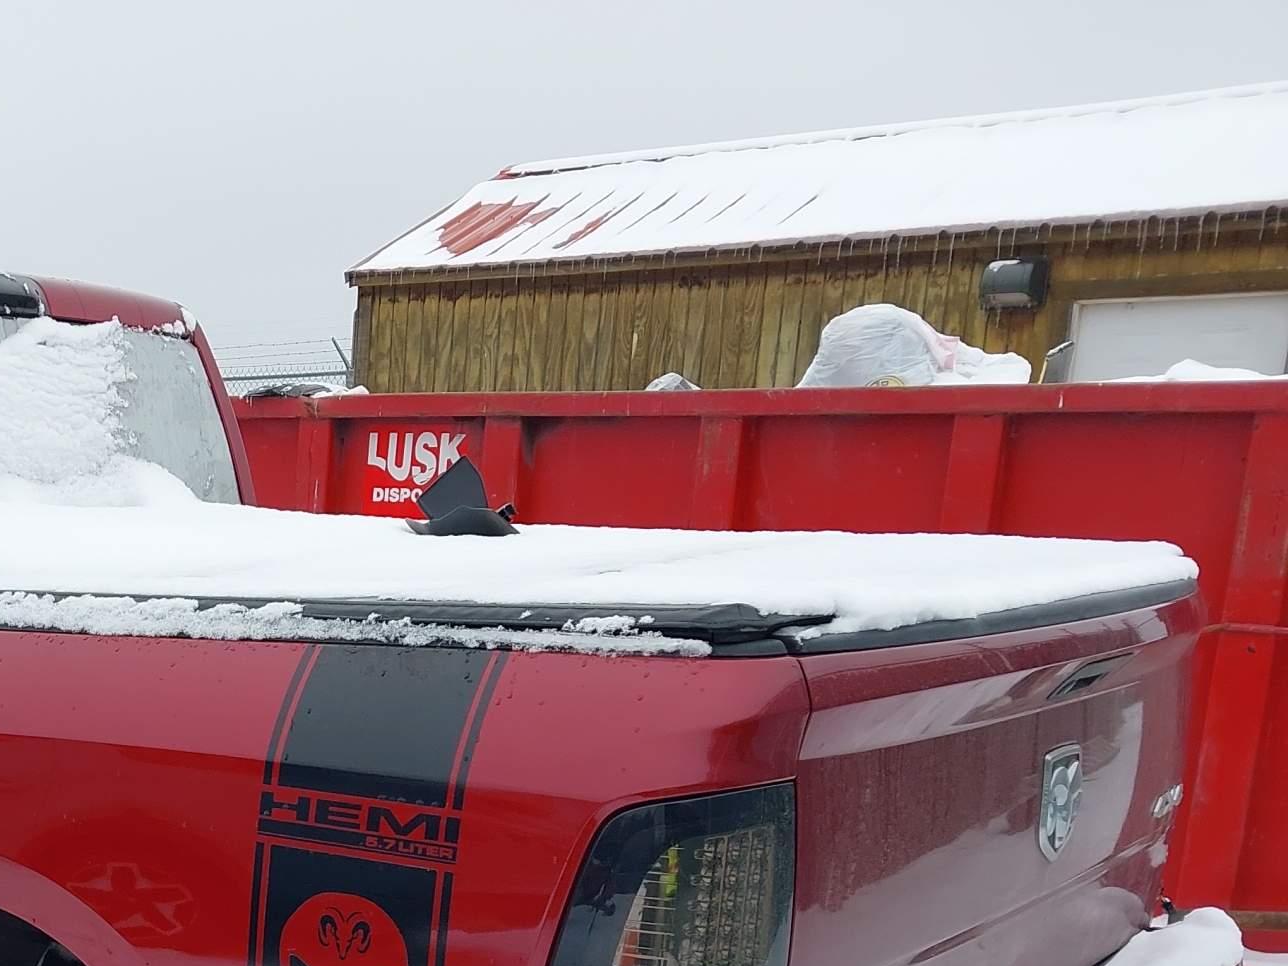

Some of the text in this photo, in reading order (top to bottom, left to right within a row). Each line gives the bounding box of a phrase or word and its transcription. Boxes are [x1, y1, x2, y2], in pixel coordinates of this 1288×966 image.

[367, 431, 466, 486] LUSK
[372, 487, 423, 503] DISPO
[261, 791, 462, 843] HEMI
[397, 840, 454, 859] LITER
